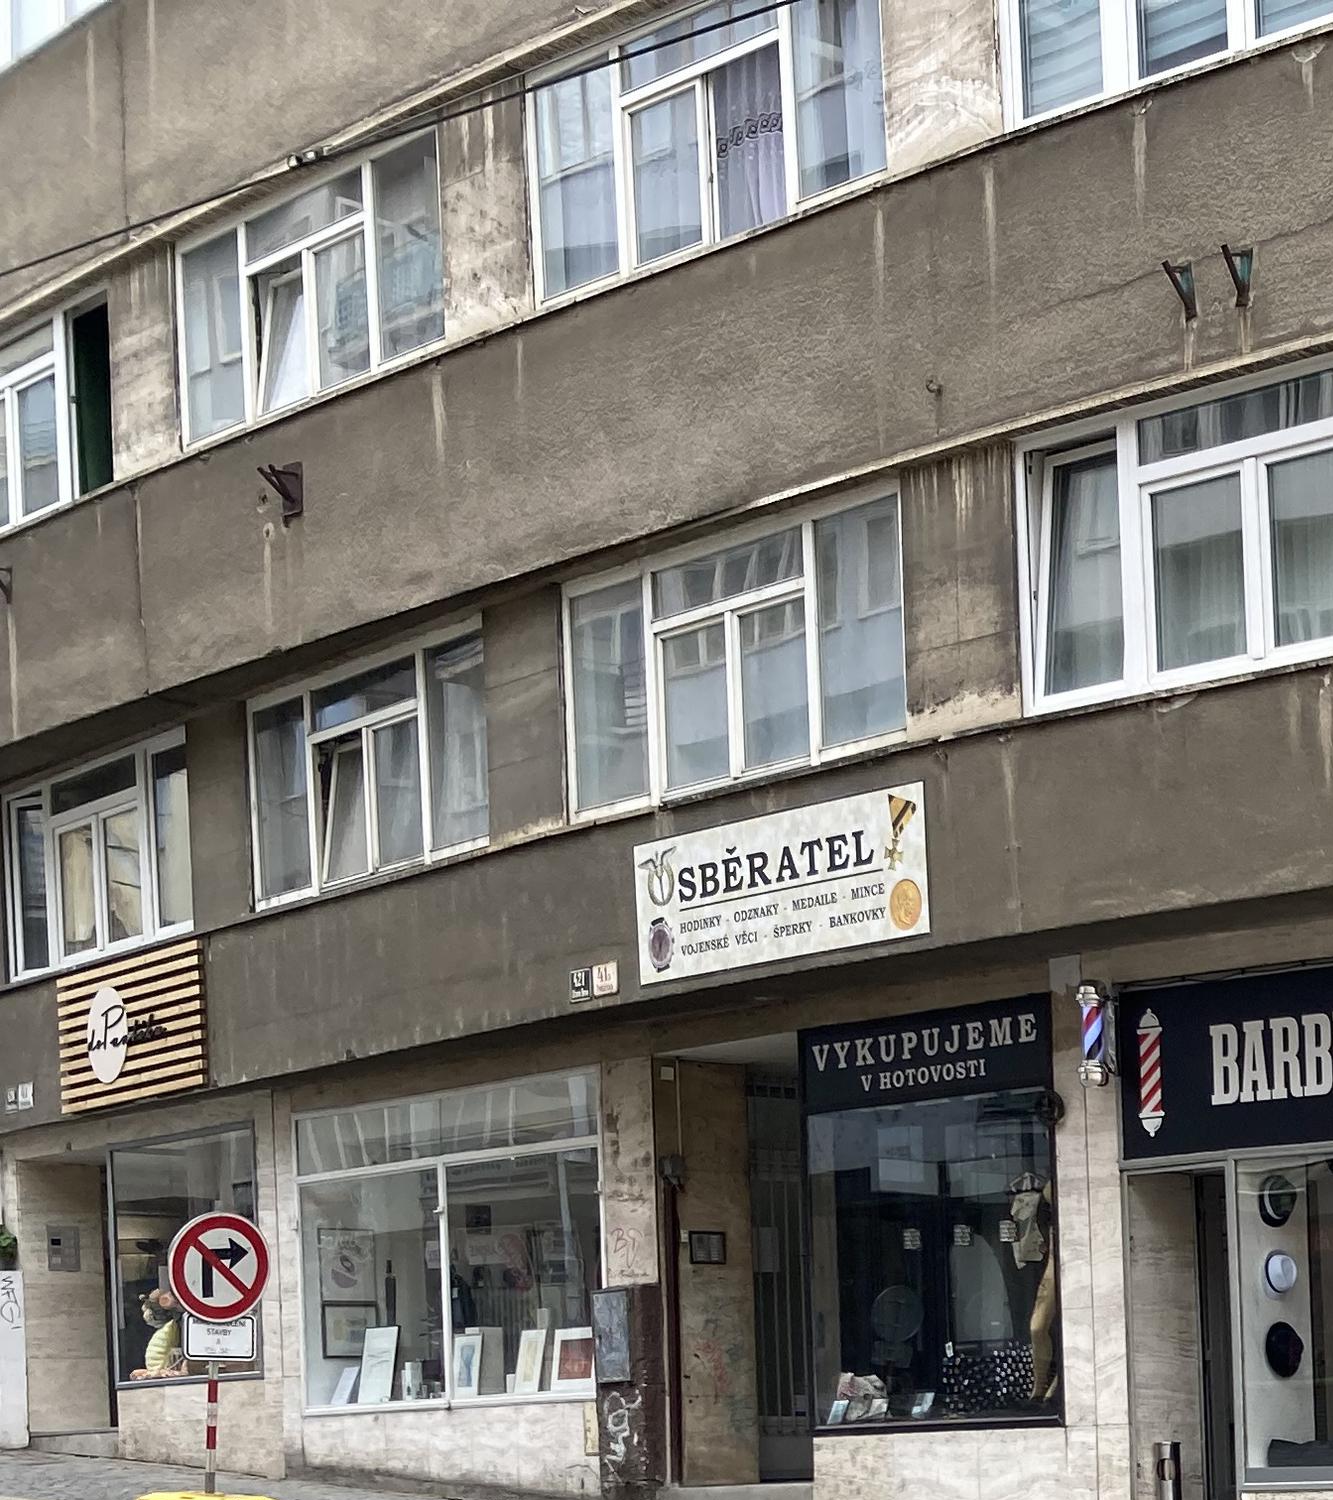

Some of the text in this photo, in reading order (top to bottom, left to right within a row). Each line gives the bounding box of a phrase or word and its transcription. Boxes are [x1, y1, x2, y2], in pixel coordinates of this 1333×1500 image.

[678, 830, 874, 903] SBĚRATEL
[679, 882, 885, 934] HODINKY ODZNAKY MEDAILE MINCE
[681, 906, 886, 956] VOJENSKÉ VĚCI ŠPERKY BANKOVKY
[812, 1013, 1037, 1072] VYKUPUJEME
[861, 1059, 987, 1092] V HOTOVOSTI
